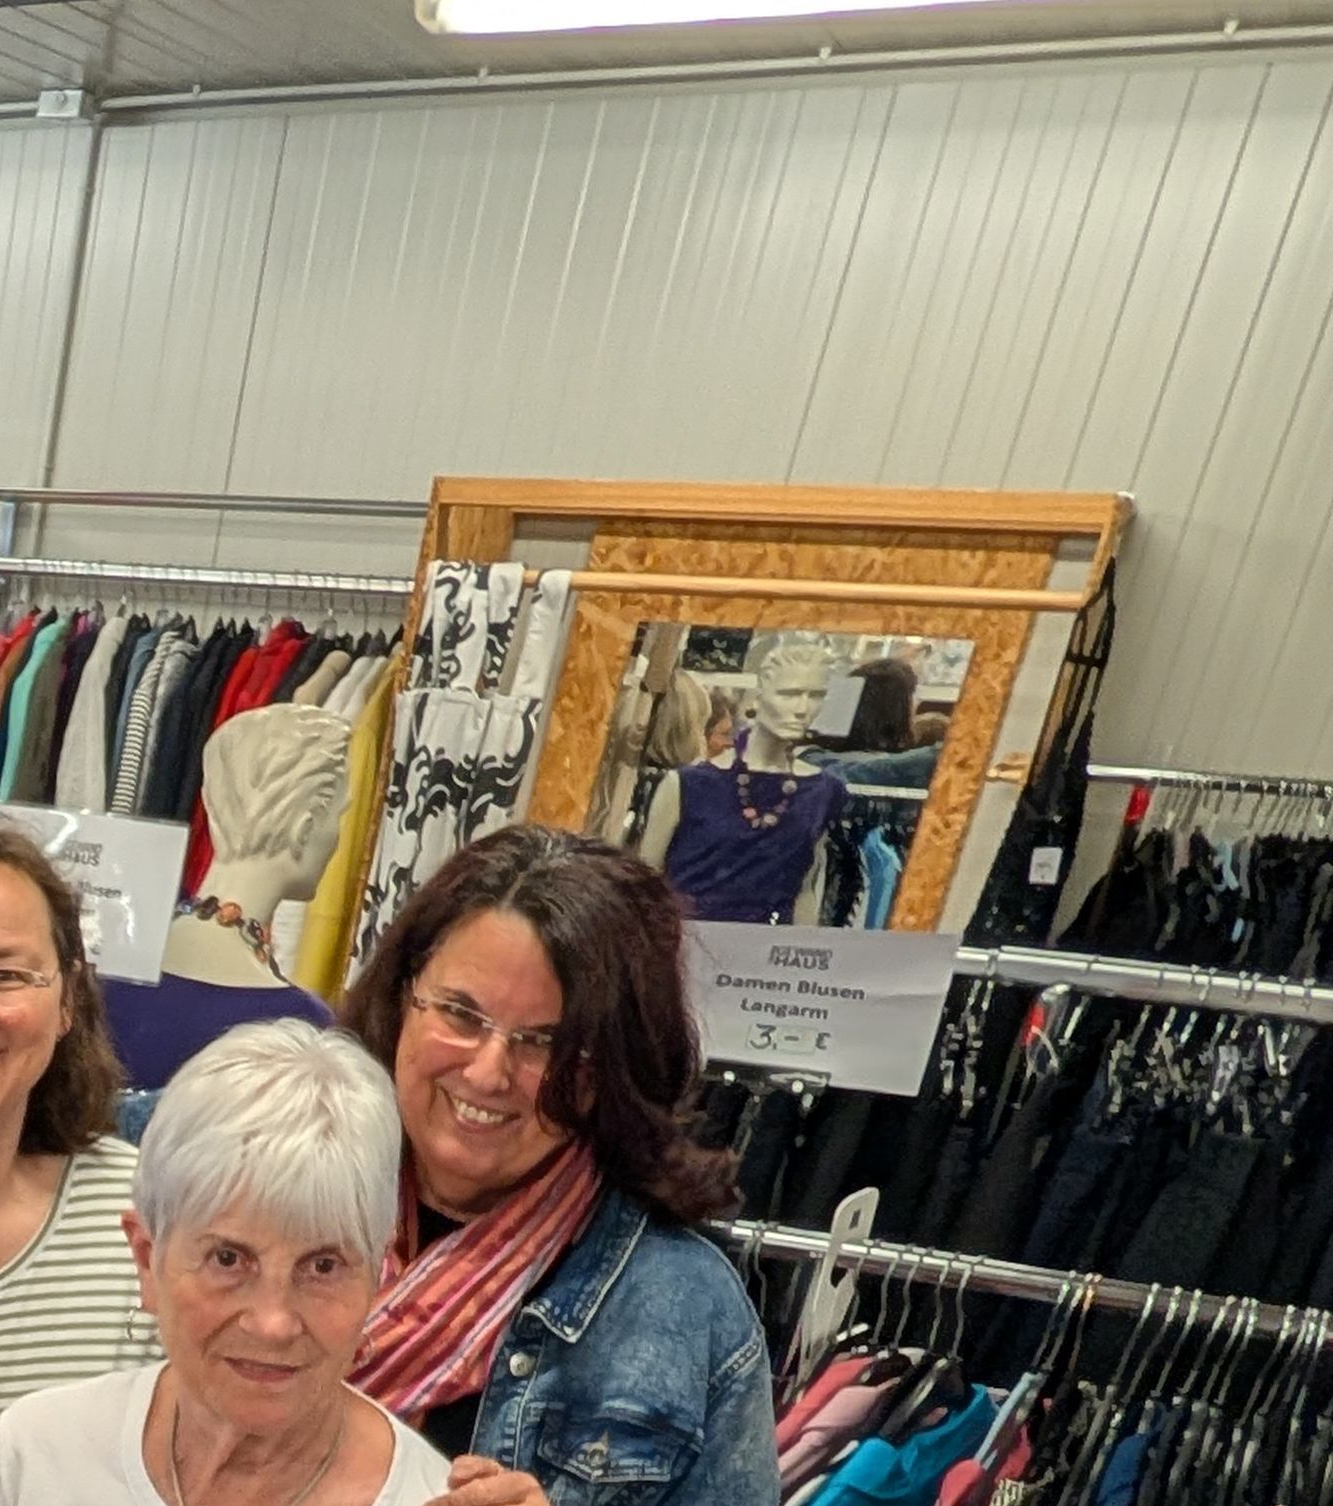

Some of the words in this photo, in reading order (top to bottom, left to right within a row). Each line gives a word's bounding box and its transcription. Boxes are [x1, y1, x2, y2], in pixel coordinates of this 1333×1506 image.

[773, 956, 830, 971] HAUS
[715, 974, 791, 993] Damen
[796, 980, 866, 1000] Blusen
[740, 998, 829, 1020] Langarm
